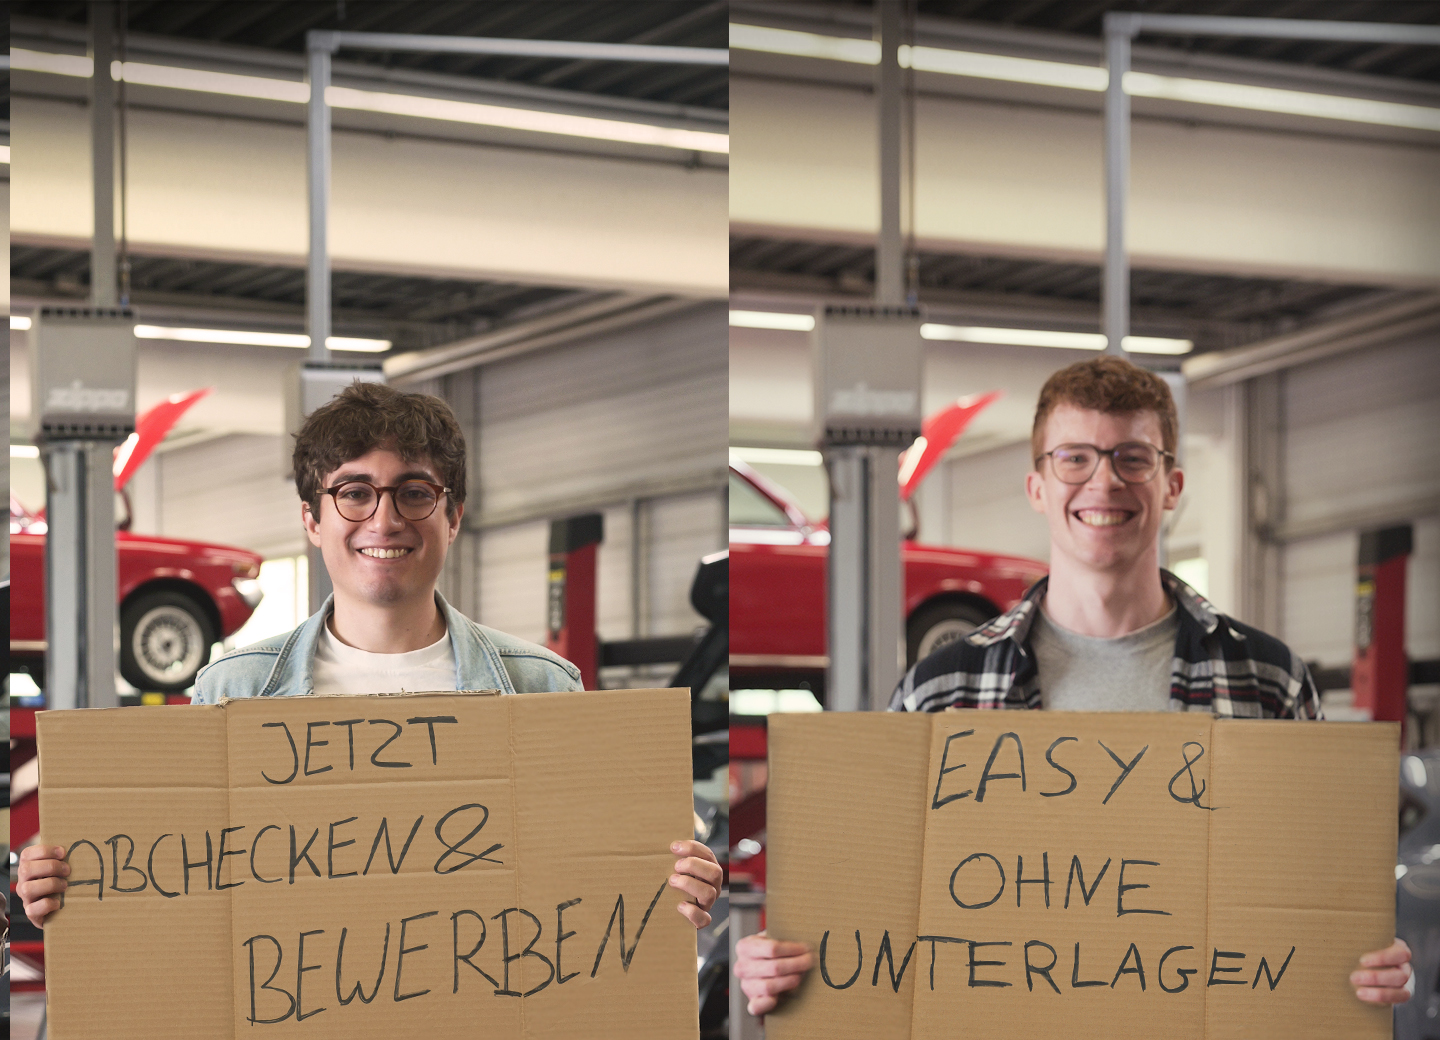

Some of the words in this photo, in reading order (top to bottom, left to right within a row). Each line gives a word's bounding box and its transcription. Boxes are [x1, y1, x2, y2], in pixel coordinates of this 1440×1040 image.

[261, 716, 458, 784] JETZT
[932, 729, 1148, 810] EASY
[1168, 742, 1228, 811] &
[61, 815, 424, 908] ABCHECKEN
[434, 803, 504, 874] &
[949, 852, 1172, 917] OHNE
[243, 878, 667, 1026] BEWERBEN
[819, 930, 1295, 994] UNTERLAGEN
